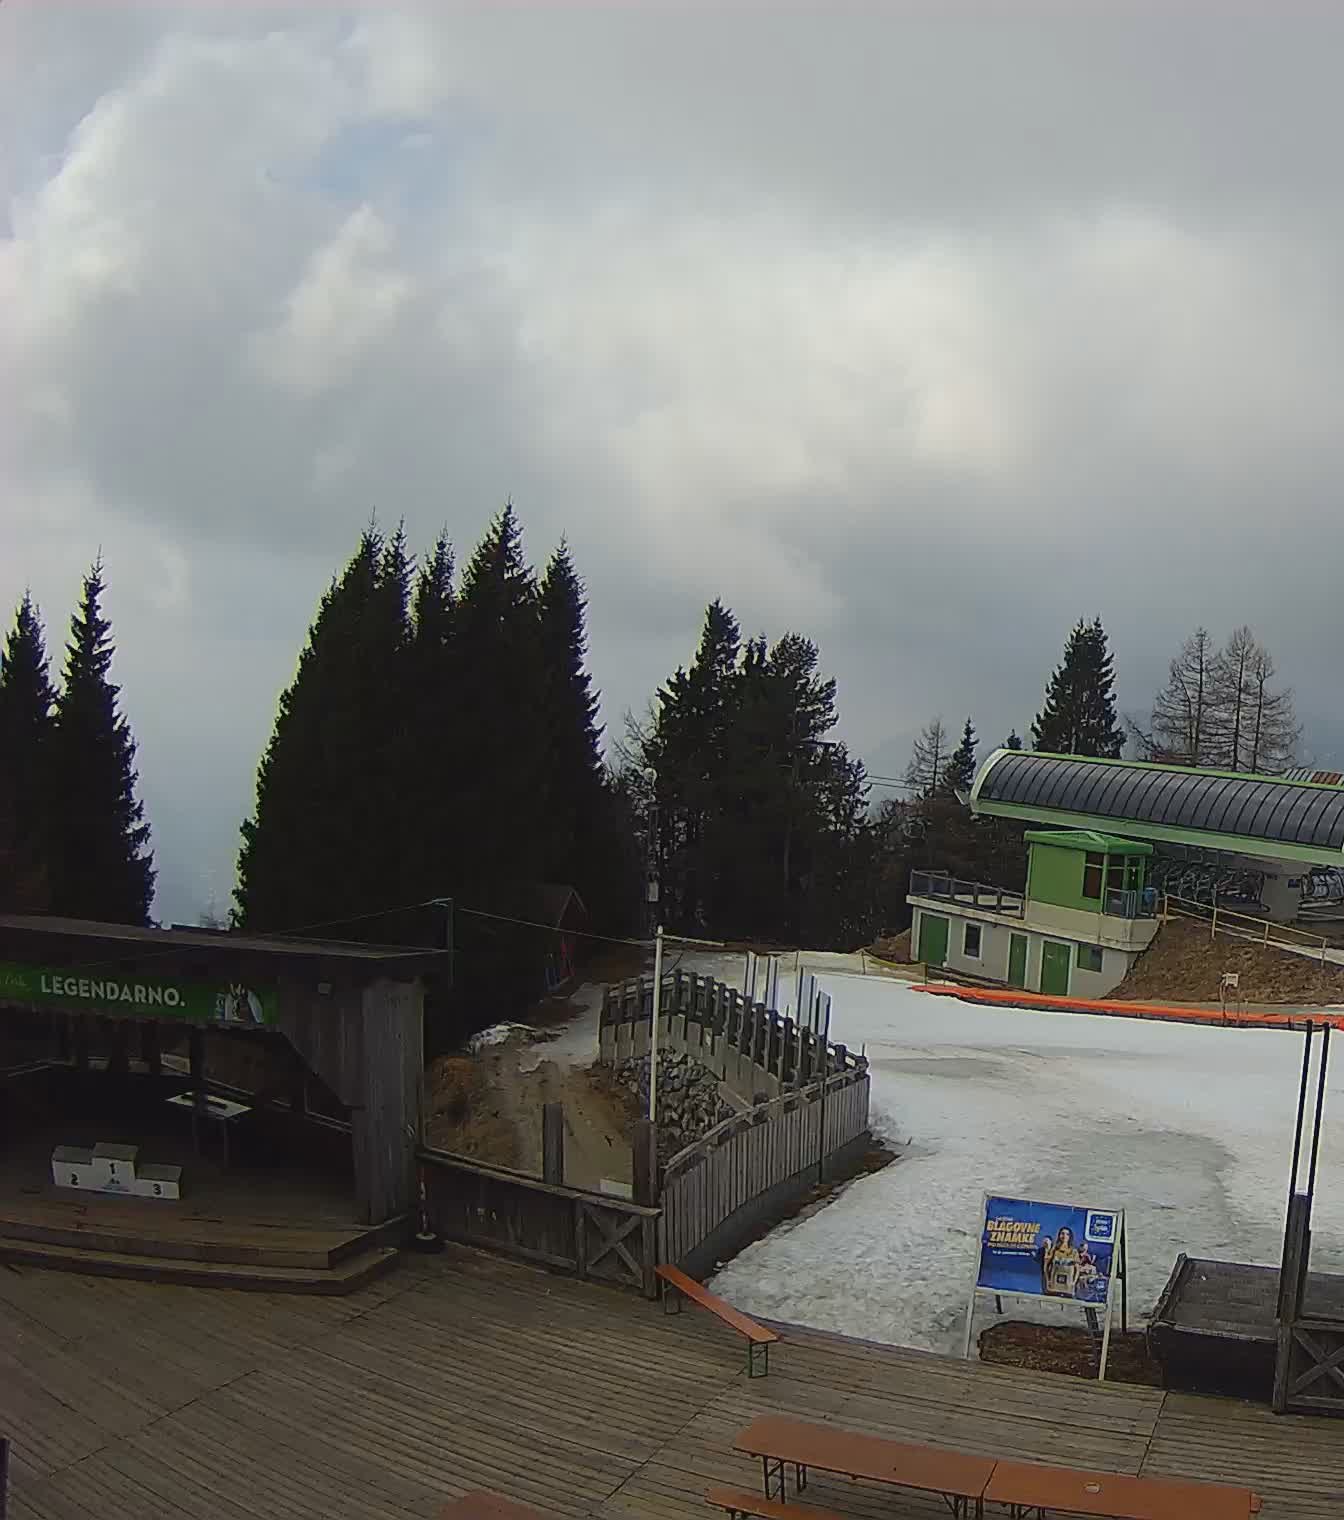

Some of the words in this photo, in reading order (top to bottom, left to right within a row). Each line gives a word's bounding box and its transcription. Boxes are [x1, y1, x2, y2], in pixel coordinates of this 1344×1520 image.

[40, 974, 186, 1007] LEGENDARNO.
[109, 1162, 116, 1175] 1
[70, 1173, 79, 1186] 2
[152, 1183, 162, 1196] 3
[986, 1220, 1041, 1234] BLAGOVNE
[990, 1231, 1036, 1243] ZNAMKE
